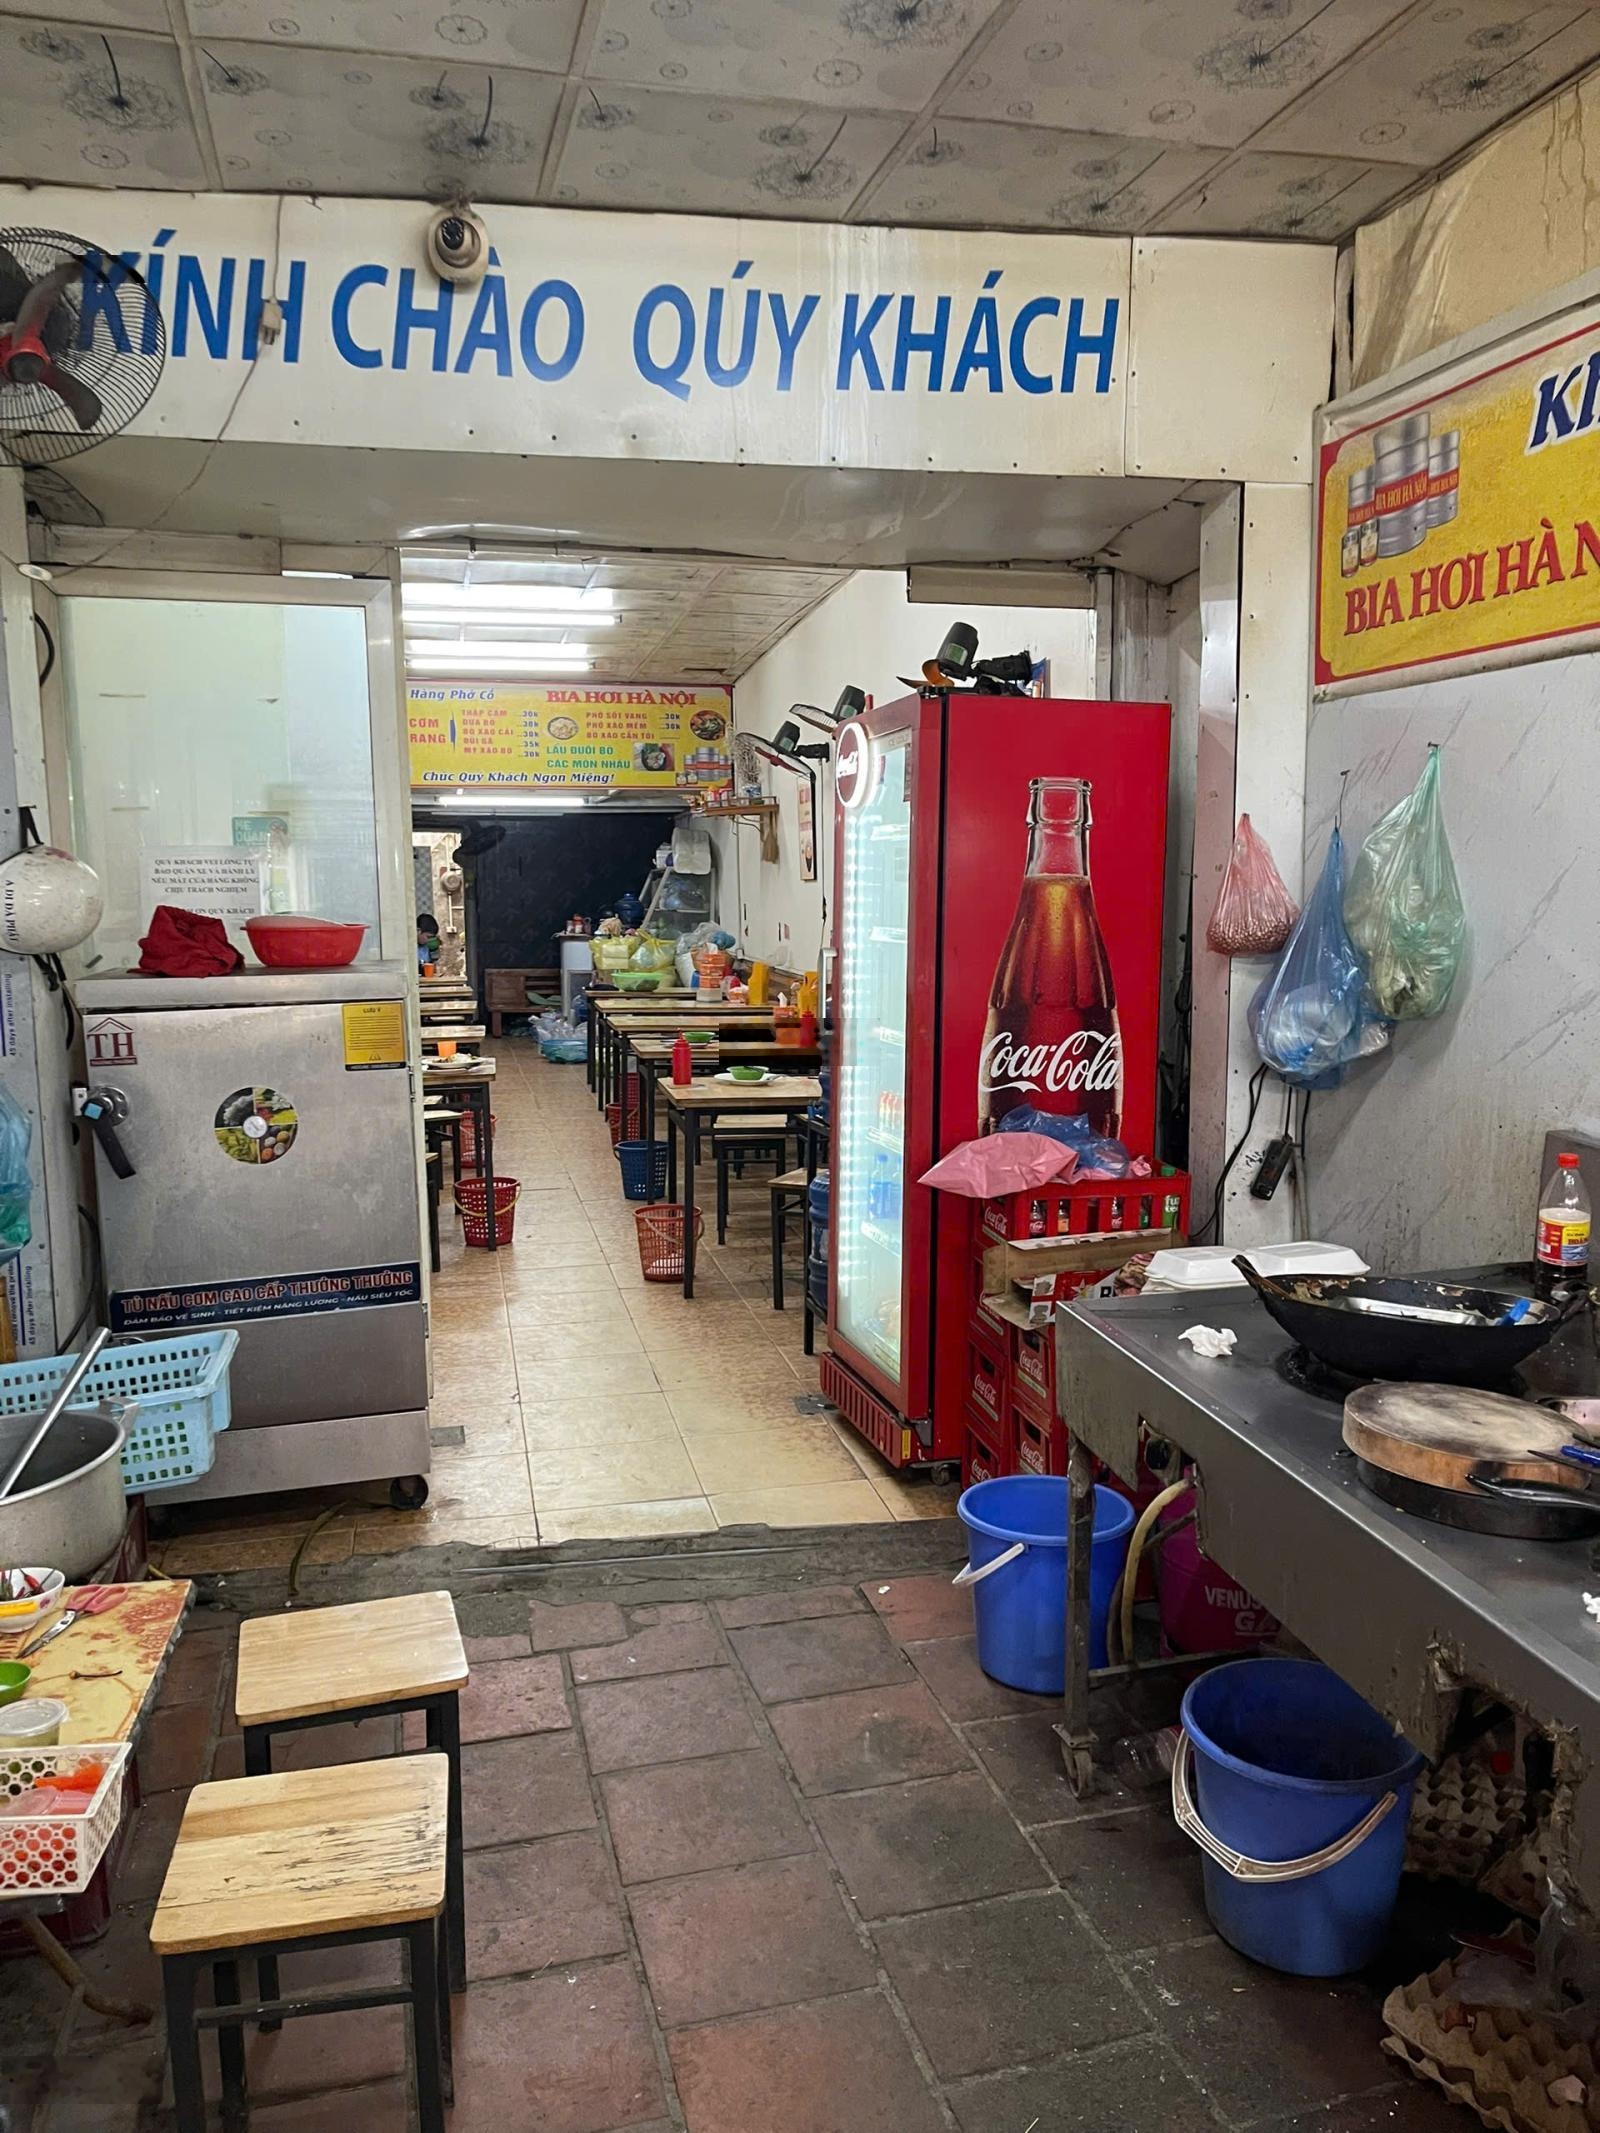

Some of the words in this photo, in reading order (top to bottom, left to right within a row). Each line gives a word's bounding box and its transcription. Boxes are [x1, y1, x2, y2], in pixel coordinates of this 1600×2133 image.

[632, 260, 821, 401] QÚY
[835, 270, 1121, 394] KHÁCH
[1343, 576, 1405, 636] BIA
[1493, 516, 1566, 599] HÀ
[546, 690, 581, 703] BIA
[626, 689, 657, 705] HÀ
[659, 690, 697, 708] NỘI
[409, 733, 447, 744] RANG
[86, 1032, 136, 1058] TH
[979, 1029, 1122, 1094] Coca-Cola
[220, 1286, 253, 1304] CAO
